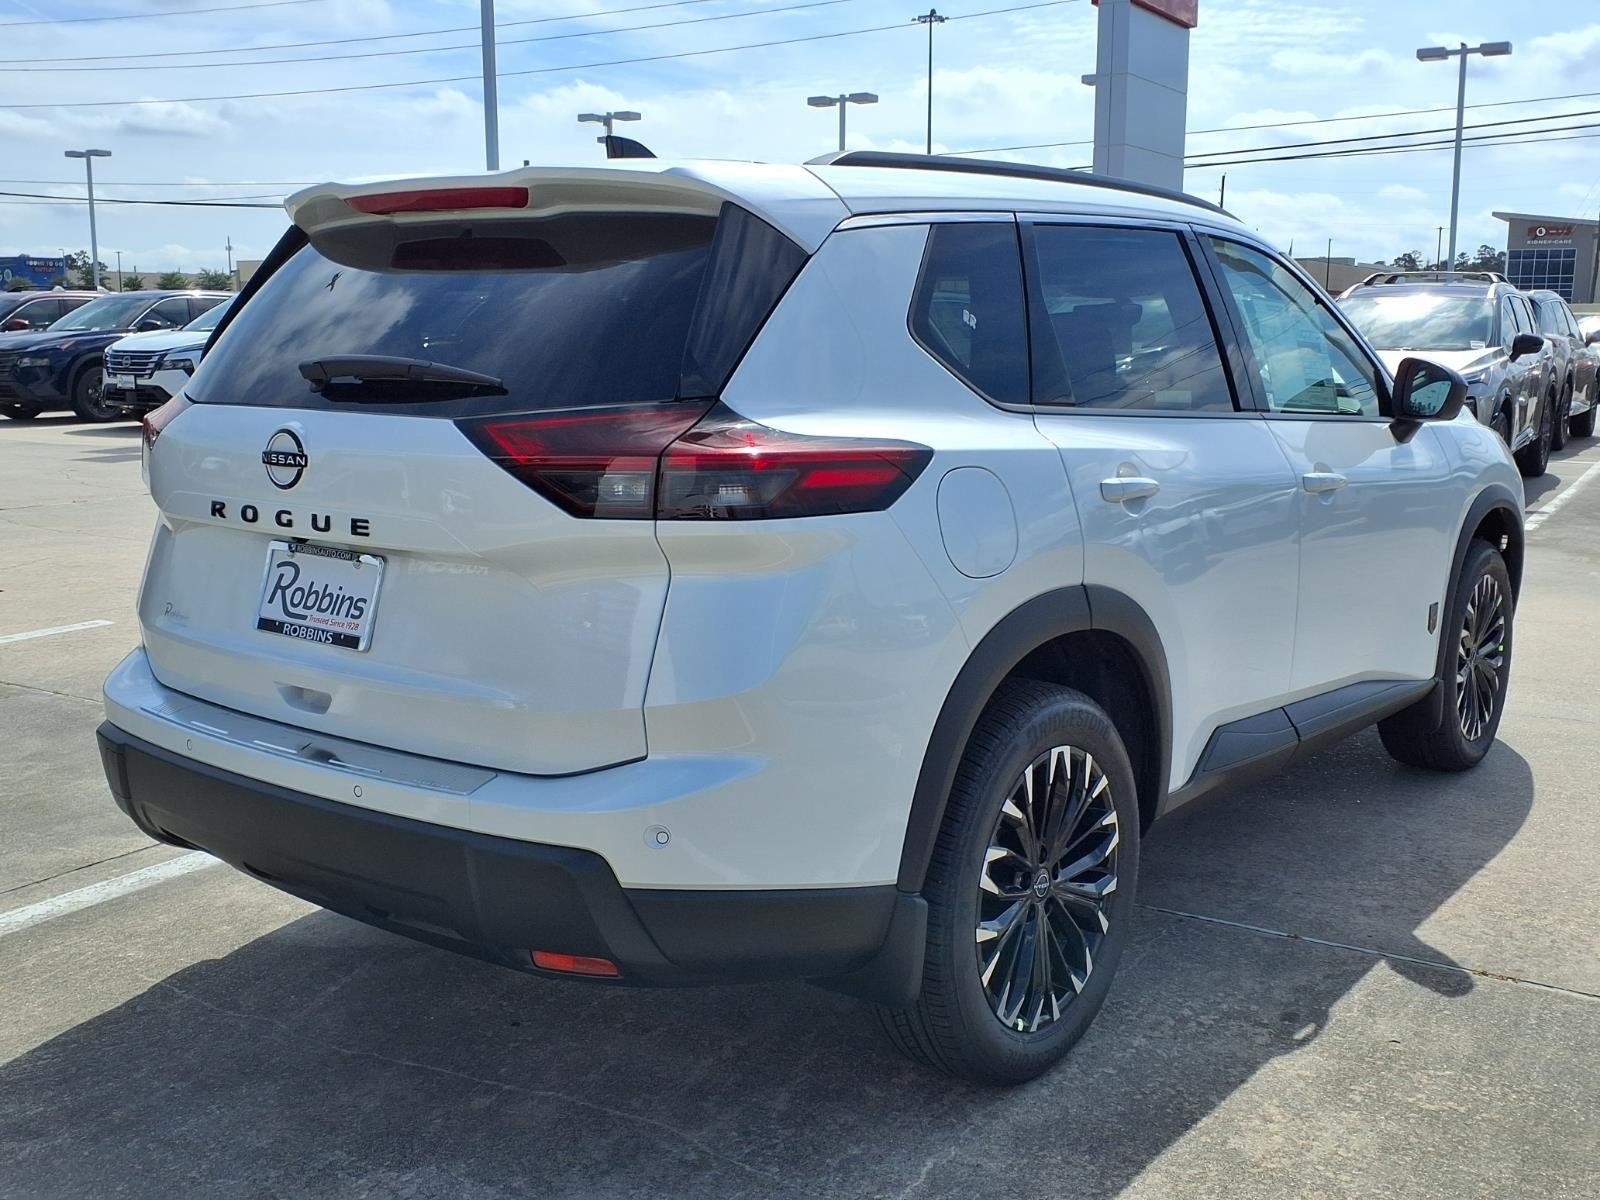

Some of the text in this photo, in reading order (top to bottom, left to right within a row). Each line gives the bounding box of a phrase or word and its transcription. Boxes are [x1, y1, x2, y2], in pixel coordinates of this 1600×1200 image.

[262, 453, 305, 466] NISSAN
[211, 500, 371, 537] ROGUE
[267, 560, 367, 621] Robbins
[309, 614, 360, 631] Trusted Since 1928
[282, 623, 333, 644] ROBBINS
